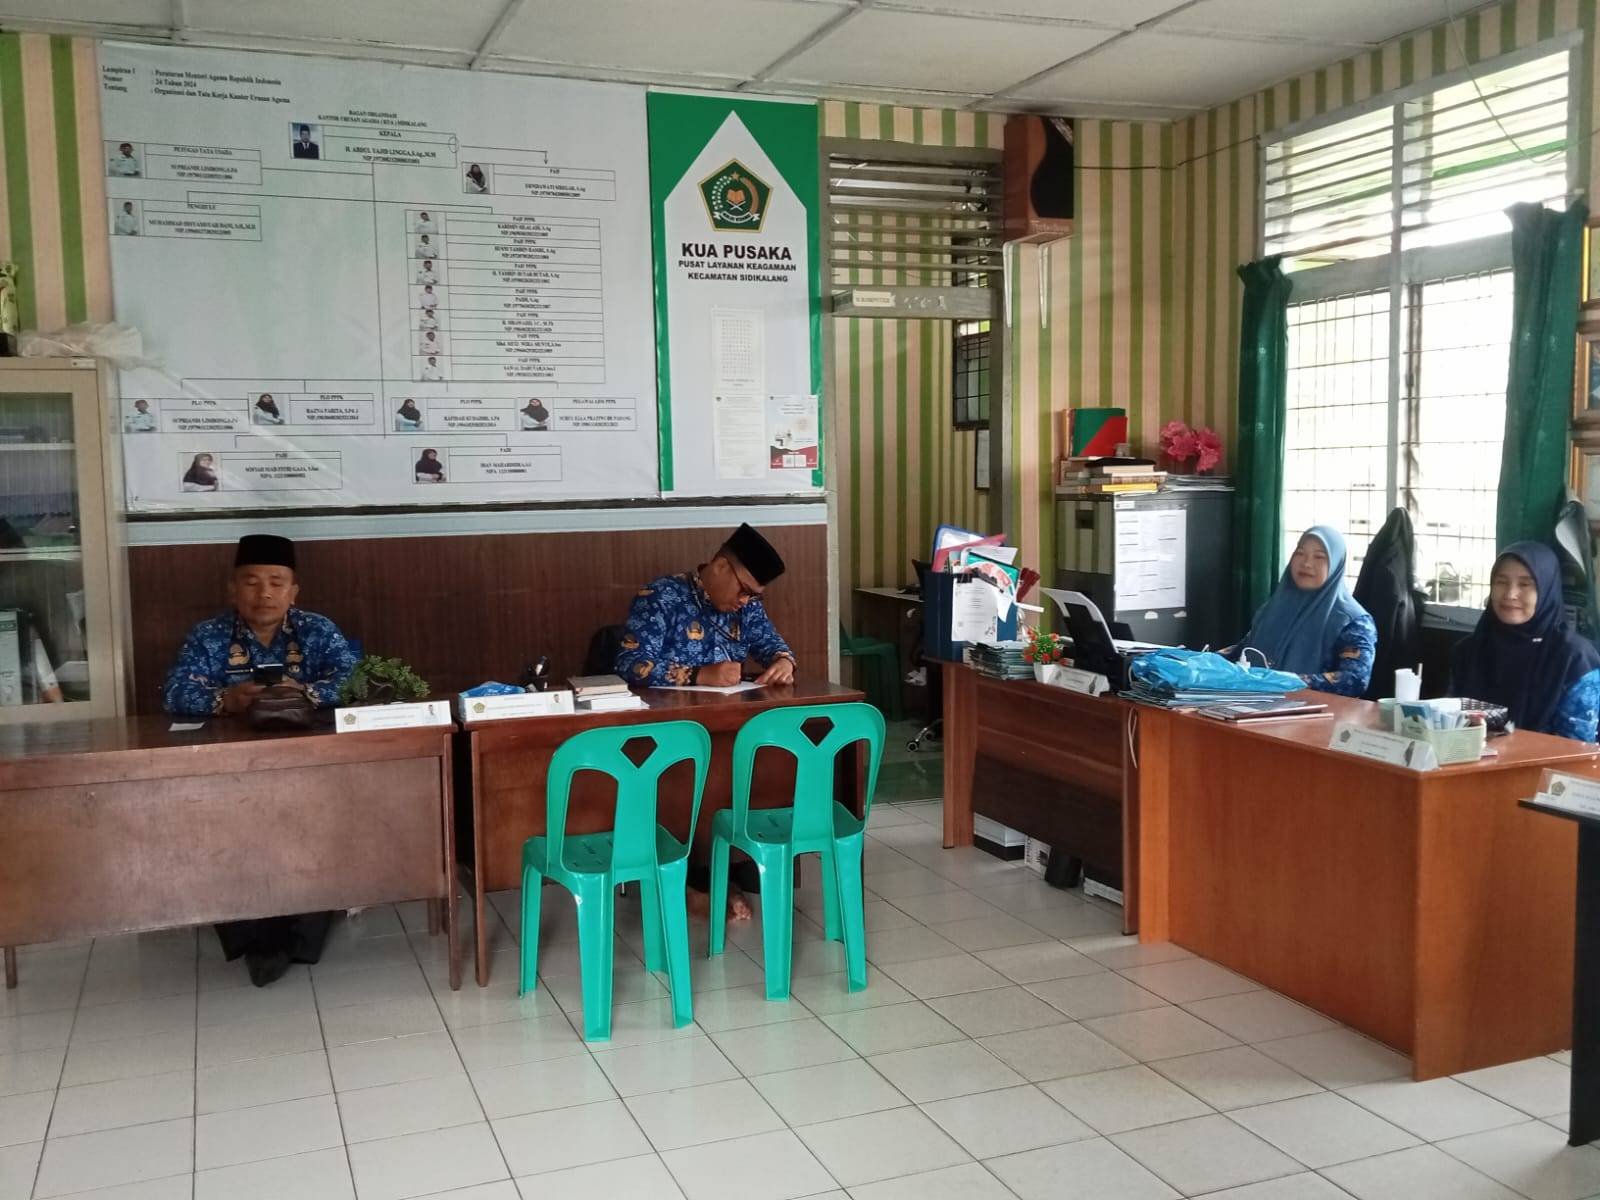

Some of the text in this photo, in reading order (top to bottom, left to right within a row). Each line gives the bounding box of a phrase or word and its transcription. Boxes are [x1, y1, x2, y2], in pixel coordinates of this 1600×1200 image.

[185, 71, 208, 80] Menteri
[209, 74, 228, 83] Agama
[229, 75, 254, 84] Republik
[154, 87, 185, 97] Organisasi
[185, 89, 196, 97] dan
[211, 91, 228, 100] Kerja
[229, 93, 249, 101] Kantor
[682, 243, 792, 260] KUA PUSAKA
[678, 260, 797, 271] PUSAT LAYANAN KEAGAMAAN
[688, 272, 788, 283] KECAMATAN SIDIKALANG
